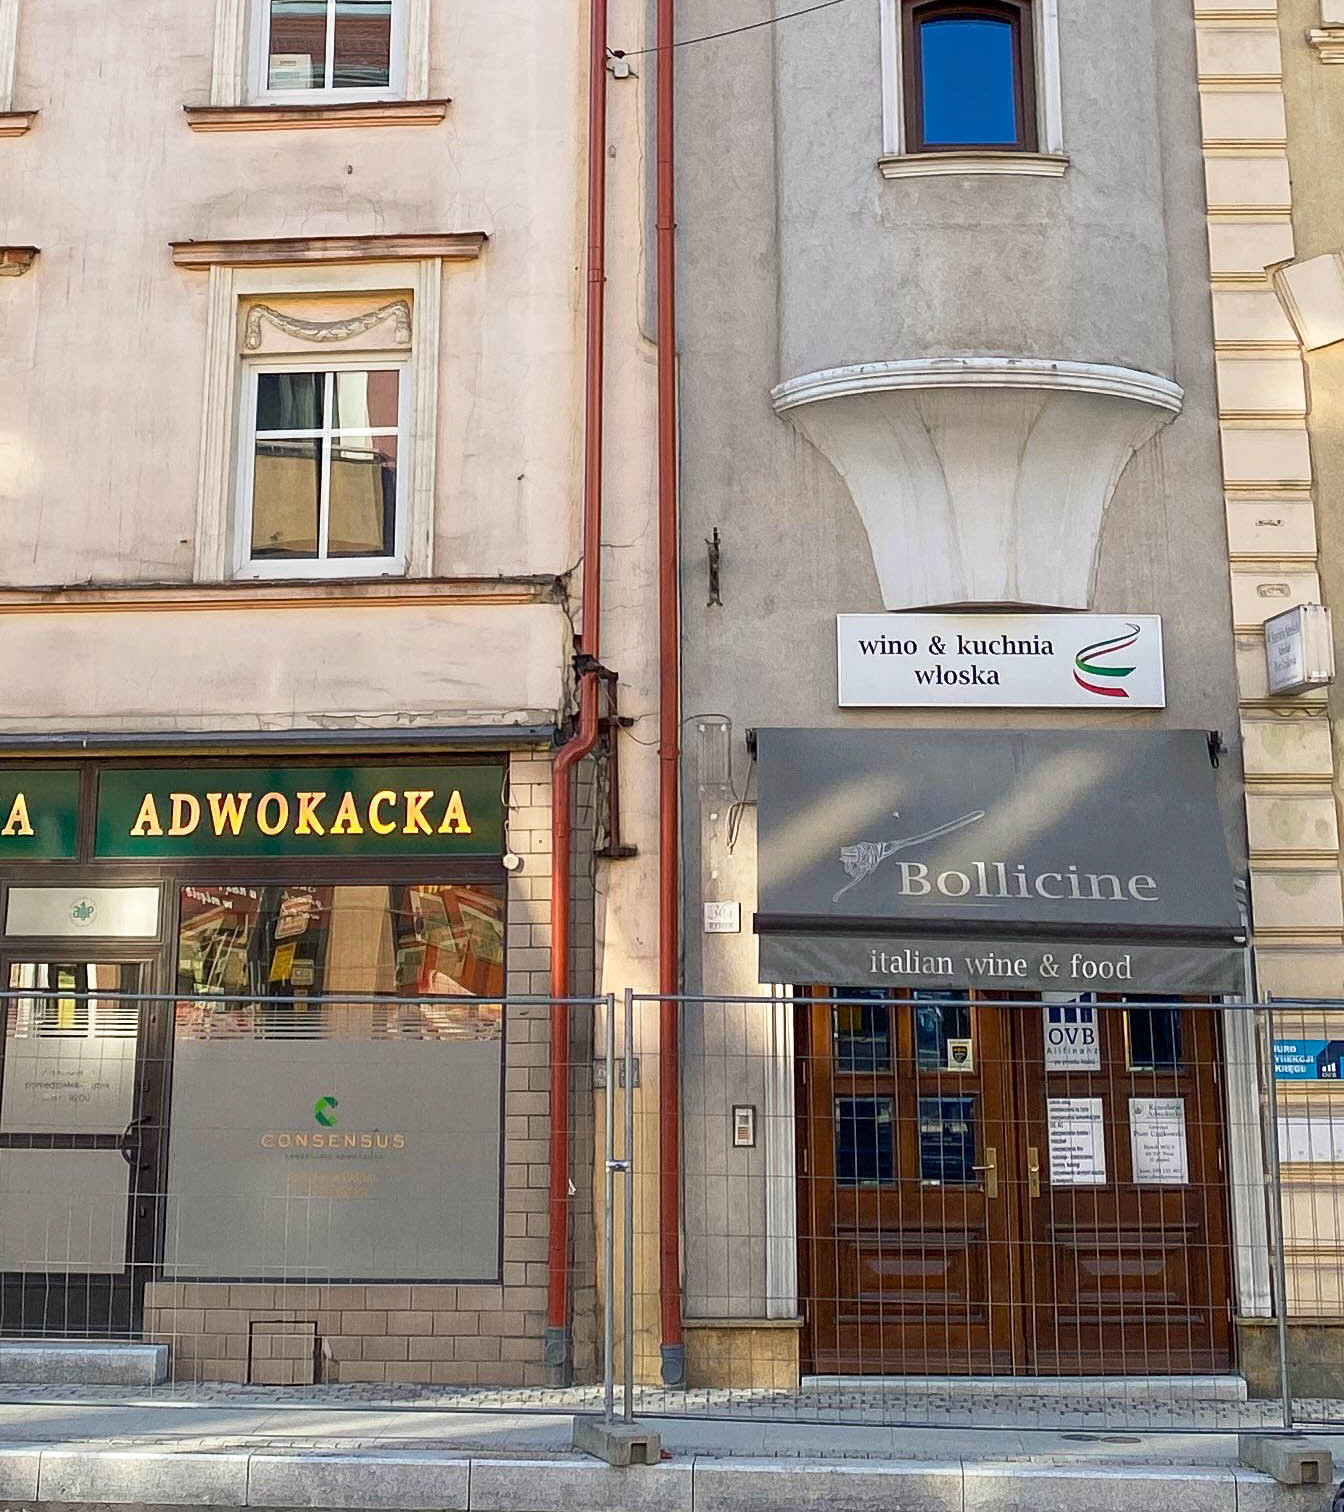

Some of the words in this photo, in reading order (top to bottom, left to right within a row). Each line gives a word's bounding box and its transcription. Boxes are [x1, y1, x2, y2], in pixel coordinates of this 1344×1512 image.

[858, 635, 918, 656] wino
[928, 635, 947, 656] &
[957, 634, 1055, 656] kuchnia
[914, 665, 1000, 686] włoska
[130, 790, 472, 836] ADWOKACKA
[896, 861, 1160, 902] Bollicine
[870, 949, 955, 976] italian
[965, 952, 1027, 978] wine
[1039, 953, 1061, 979] &
[1069, 952, 1133, 980] food
[1048, 1028, 1095, 1045] OVB
[1273, 1045, 1297, 1053] IURO
[1275, 1064, 1307, 1074] KRĘGU
[261, 1134, 405, 1149] CONSENSUS
